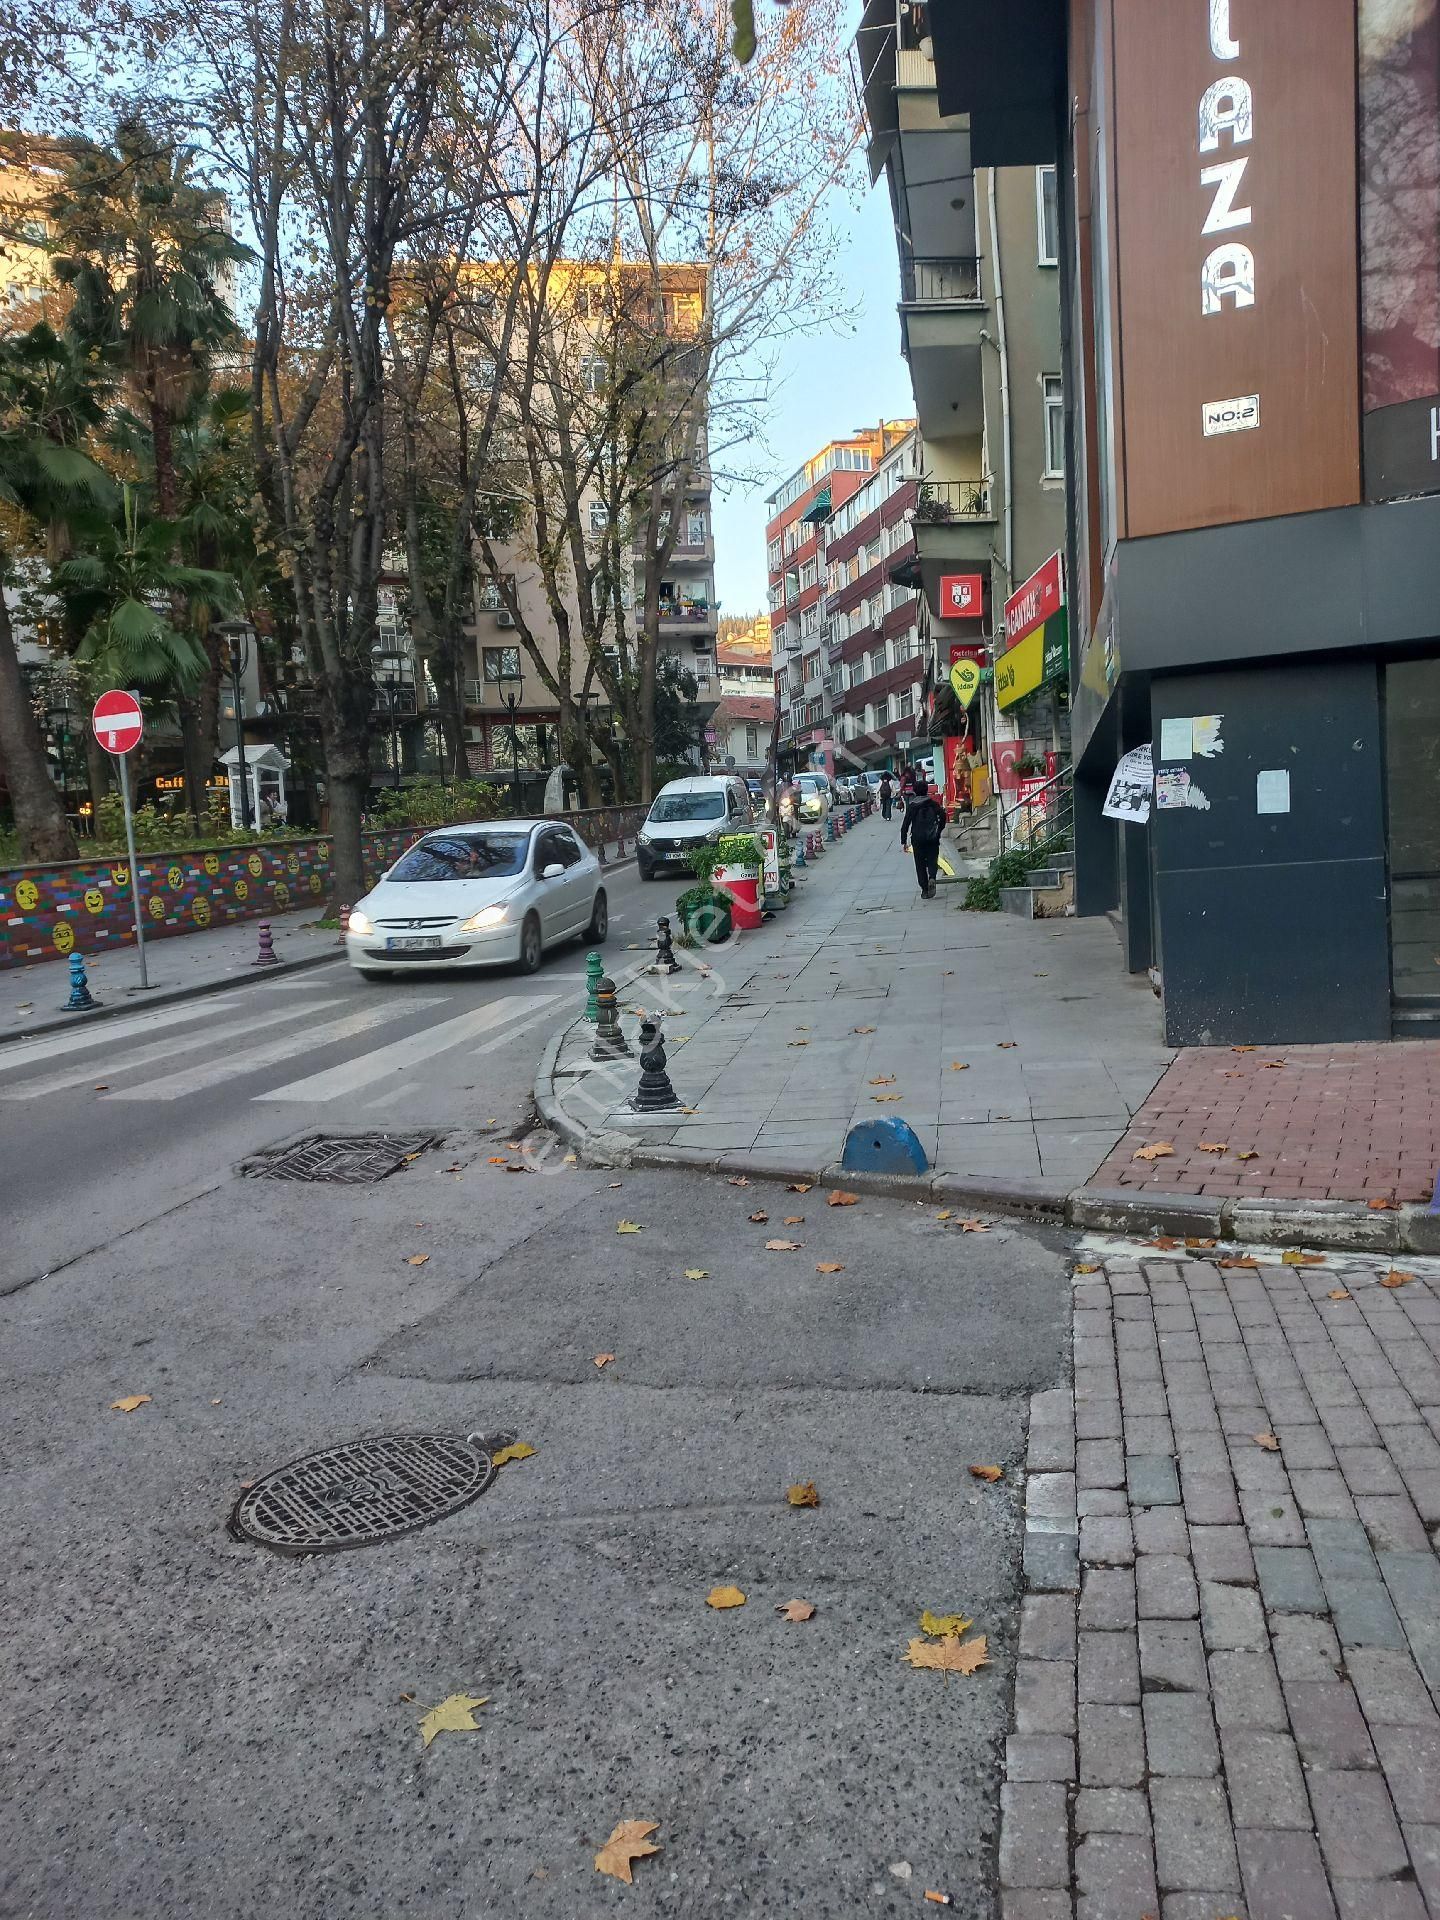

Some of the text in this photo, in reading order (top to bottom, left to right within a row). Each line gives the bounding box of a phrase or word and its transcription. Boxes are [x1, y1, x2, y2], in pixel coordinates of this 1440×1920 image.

[1208, 407, 1255, 424] NO:2
[957, 683, 974, 691] iddaa
[155, 776, 185, 789] Caff
[764, 871, 777, 882] AN
